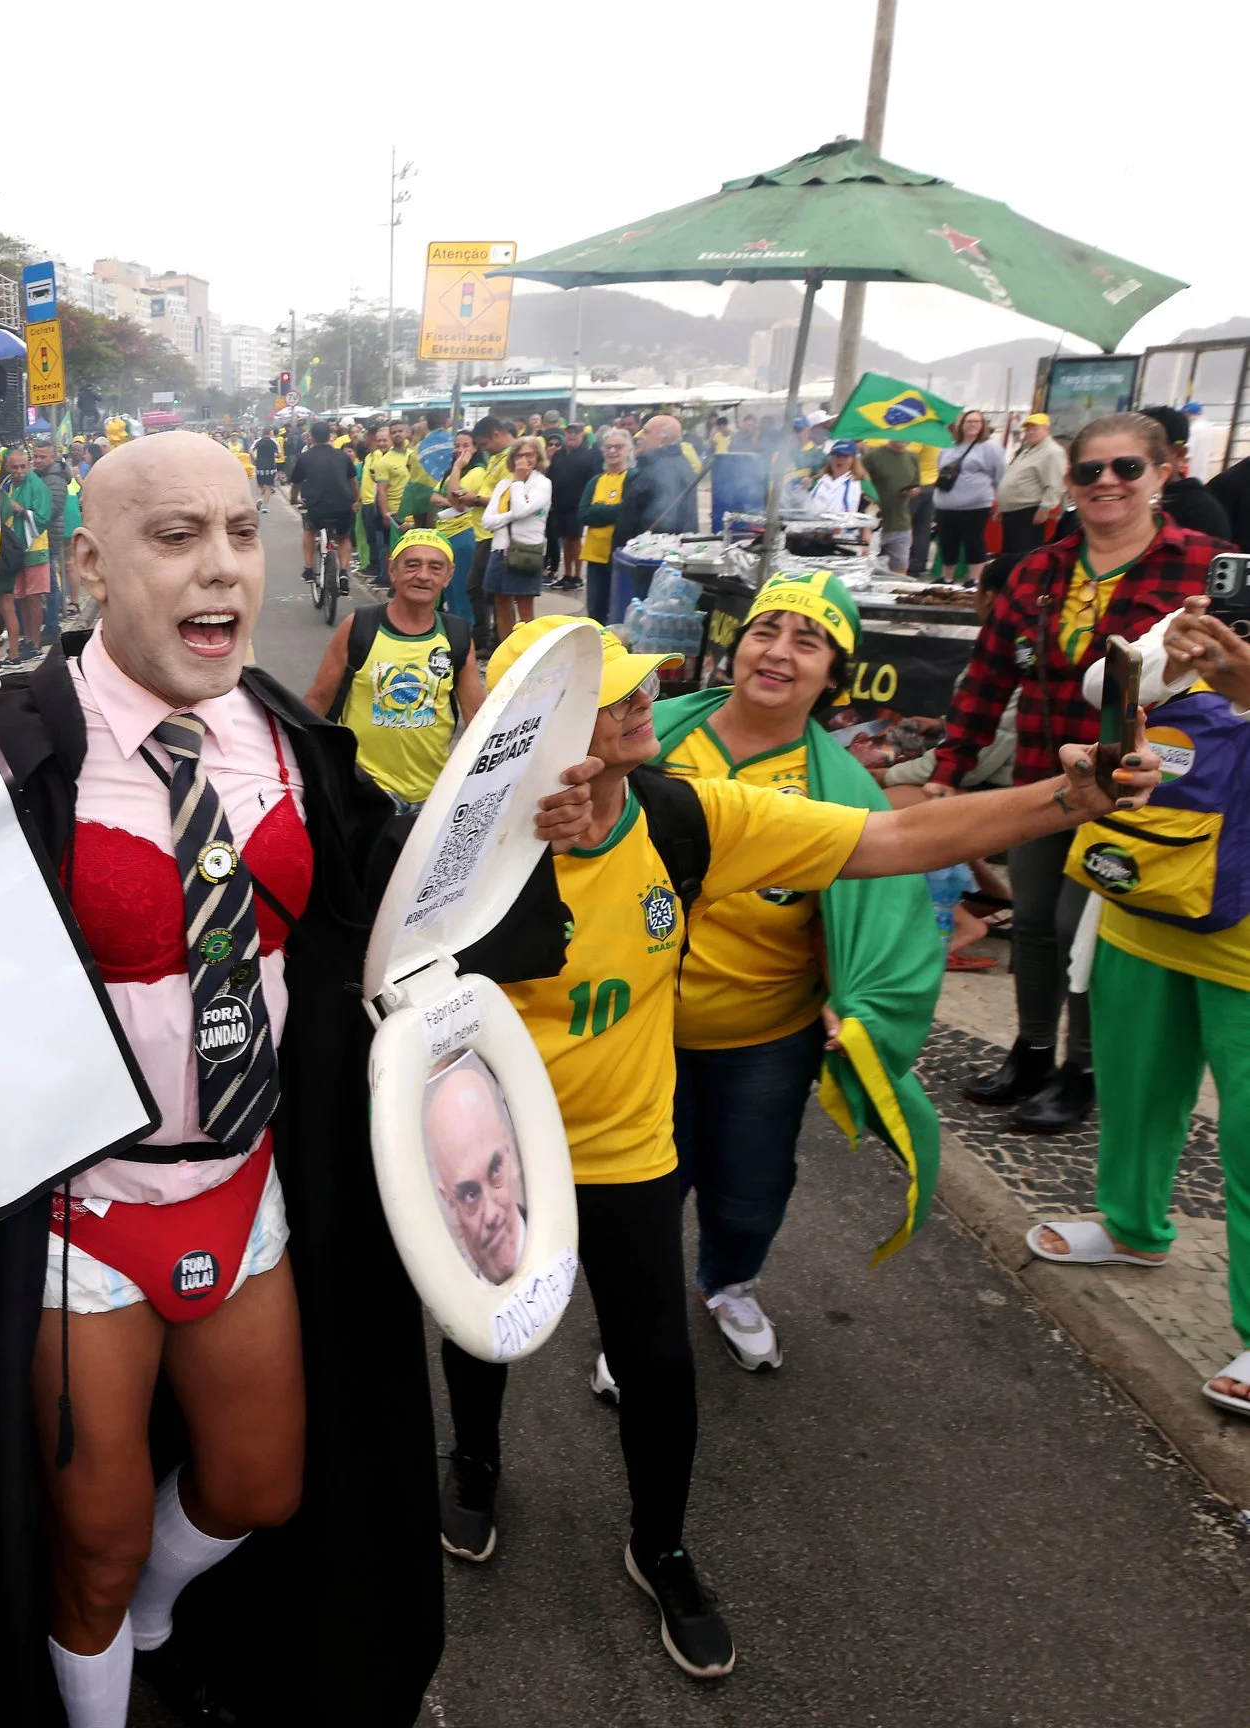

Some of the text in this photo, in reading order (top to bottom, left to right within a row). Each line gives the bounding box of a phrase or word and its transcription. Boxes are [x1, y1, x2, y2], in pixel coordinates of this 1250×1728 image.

[433, 248, 488, 261] Atenção
[30, 327, 55, 336] Ciclista
[426, 332, 502, 343] Fiscalização
[33, 382, 60, 392] Respeite
[42, 392, 59, 401] sinal
[406, 534, 440, 543] BRASIL
[755, 593, 814, 609] BRASIL
[852, 662, 898, 702] LO
[372, 704, 437, 729] BRASIL
[520, 716, 542, 736] SUA
[200, 930, 232, 952] SUPREMO
[203, 1005, 242, 1024] FORA
[425, 990, 474, 1028] Fabrica de
[568, 978, 631, 1038] 10
[200, 1018, 246, 1050] XANDÃO
[455, 1020, 480, 1043] news
[181, 1254, 213, 1275] FORA
[181, 1270, 213, 1291] LULA!
